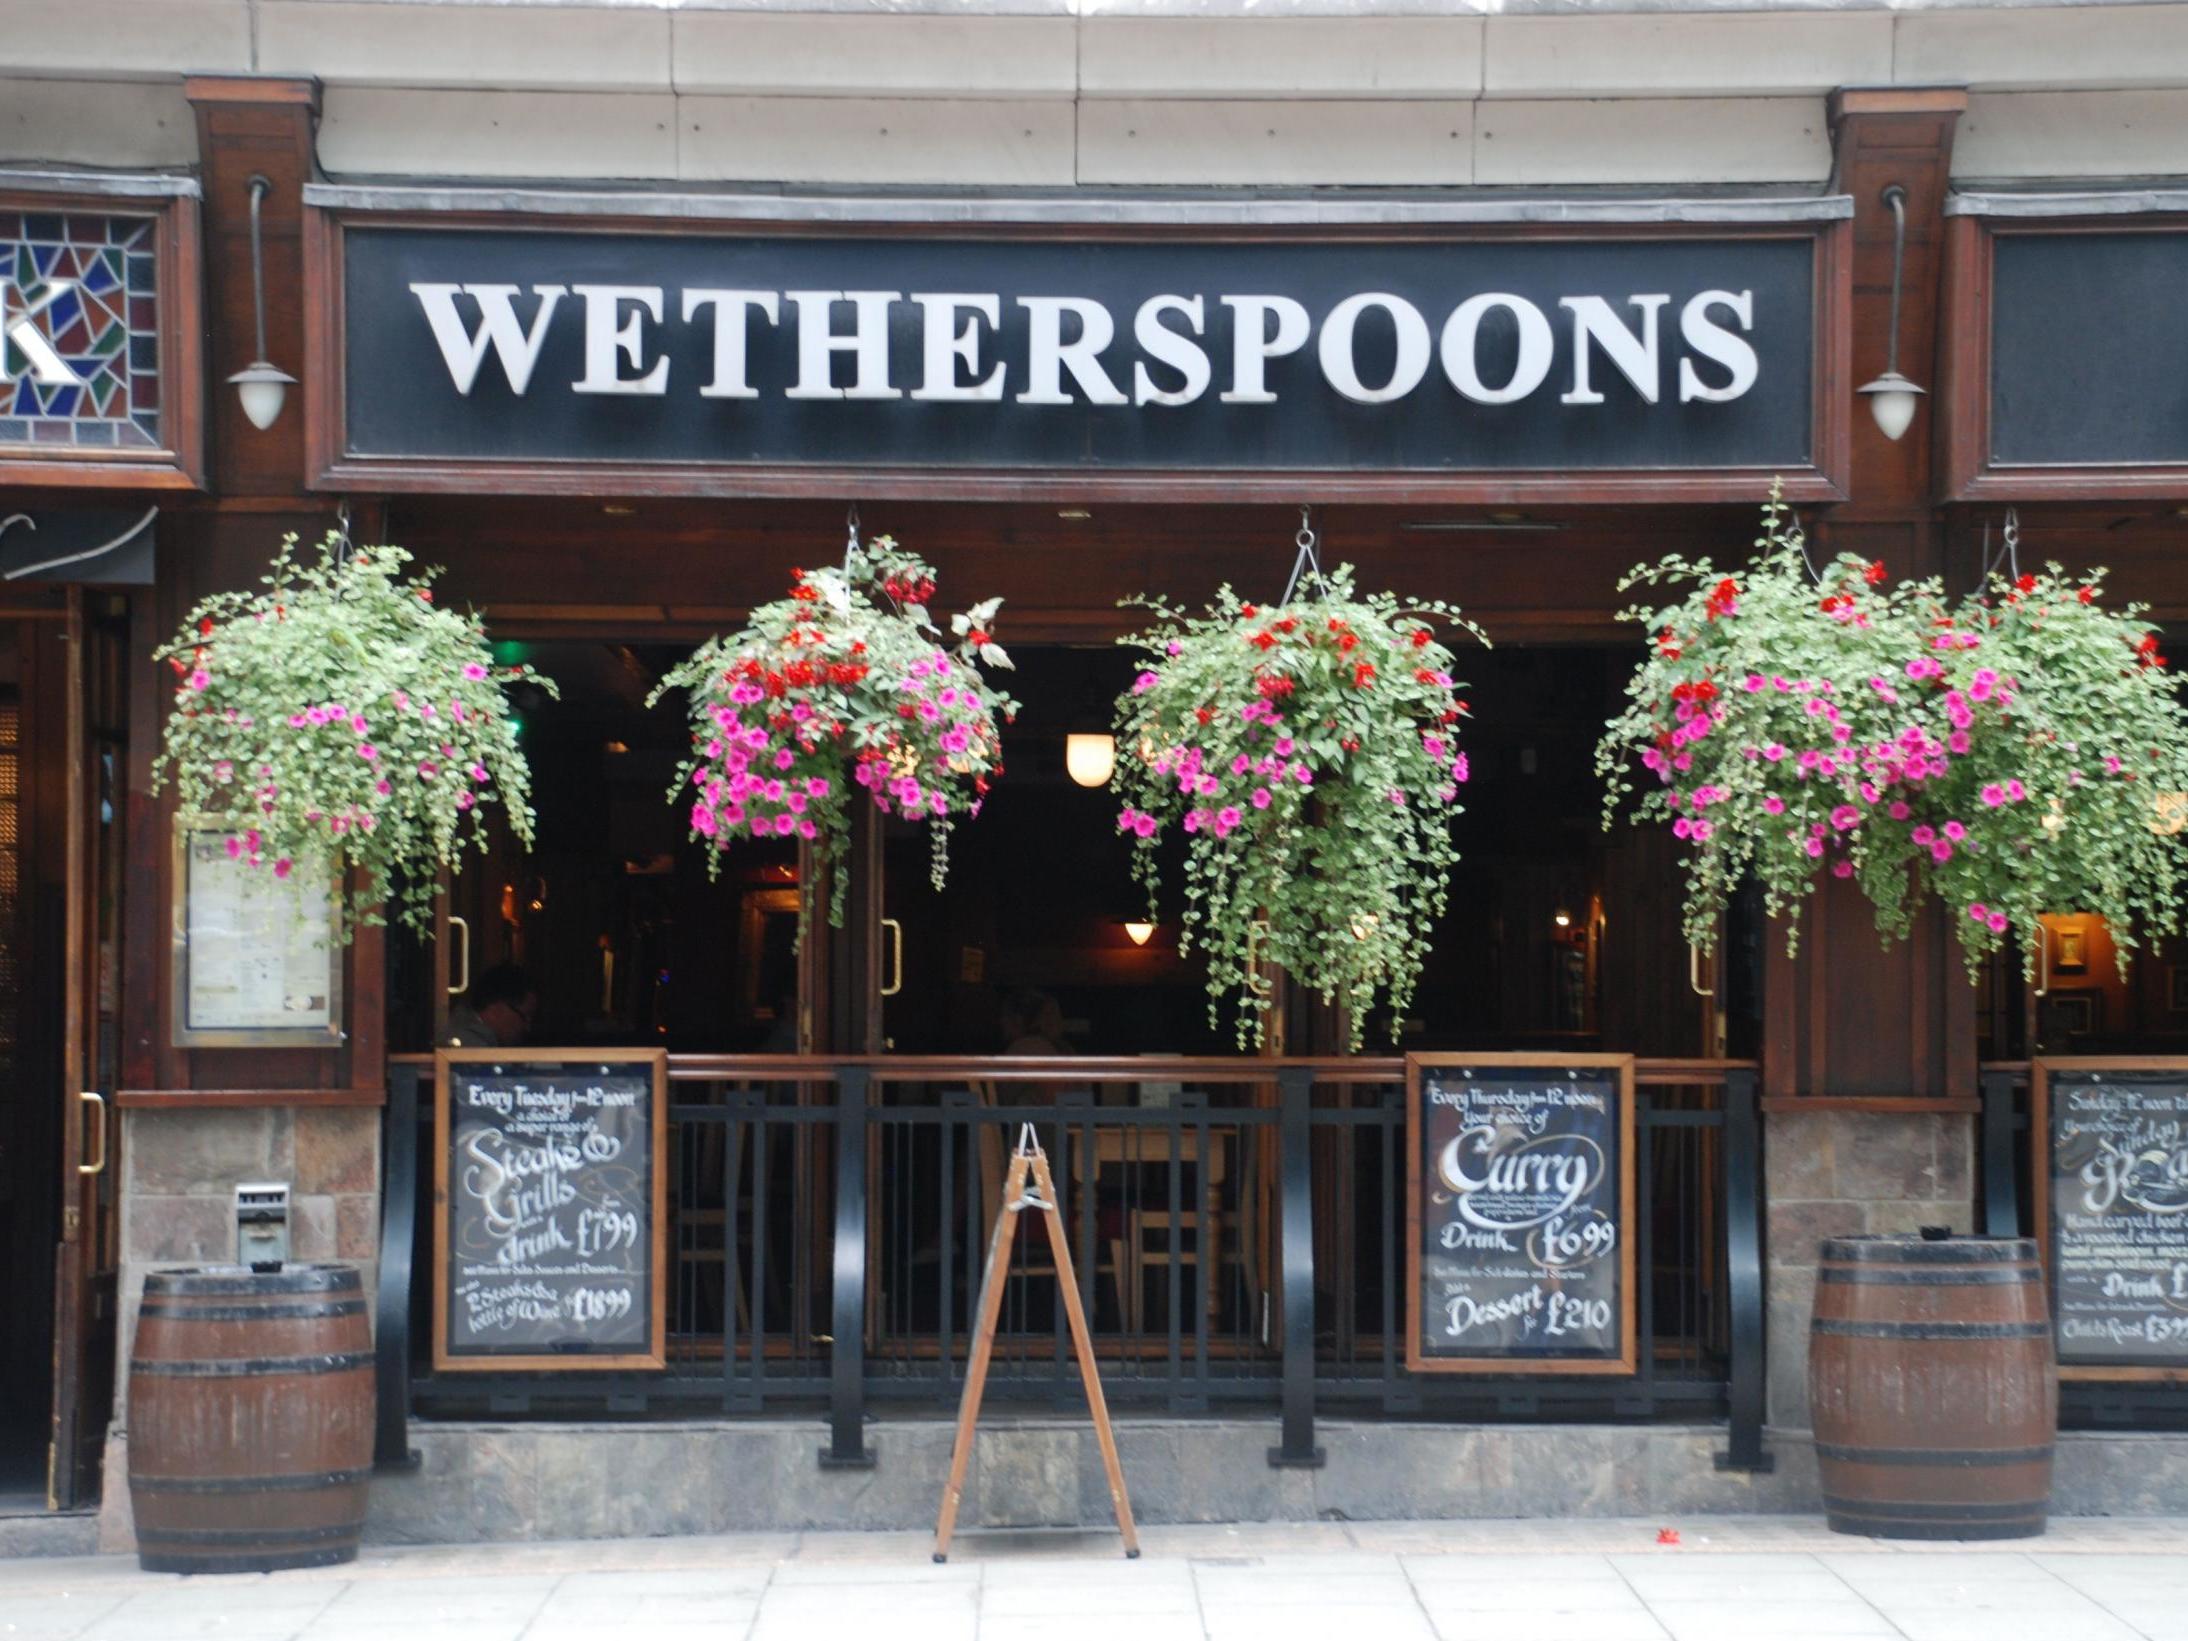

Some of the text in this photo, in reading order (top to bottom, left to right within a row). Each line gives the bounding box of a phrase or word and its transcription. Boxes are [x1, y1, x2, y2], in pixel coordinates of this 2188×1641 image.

[408, 282, 1760, 407] WETHERSPOONS
[468, 1085, 513, 1115] Every
[514, 1085, 568, 1114] Tuesday
[1430, 1087, 1469, 1112] Every
[1469, 1088, 1530, 1113] Thursday
[1439, 1124, 1589, 1231] Curry
[483, 1171, 577, 1239] Grills
[497, 1215, 573, 1264] drink
[1440, 1221, 1519, 1252] Drink
[2102, 1271, 2166, 1297] Drink
[1445, 1283, 1544, 1336] Dessert
